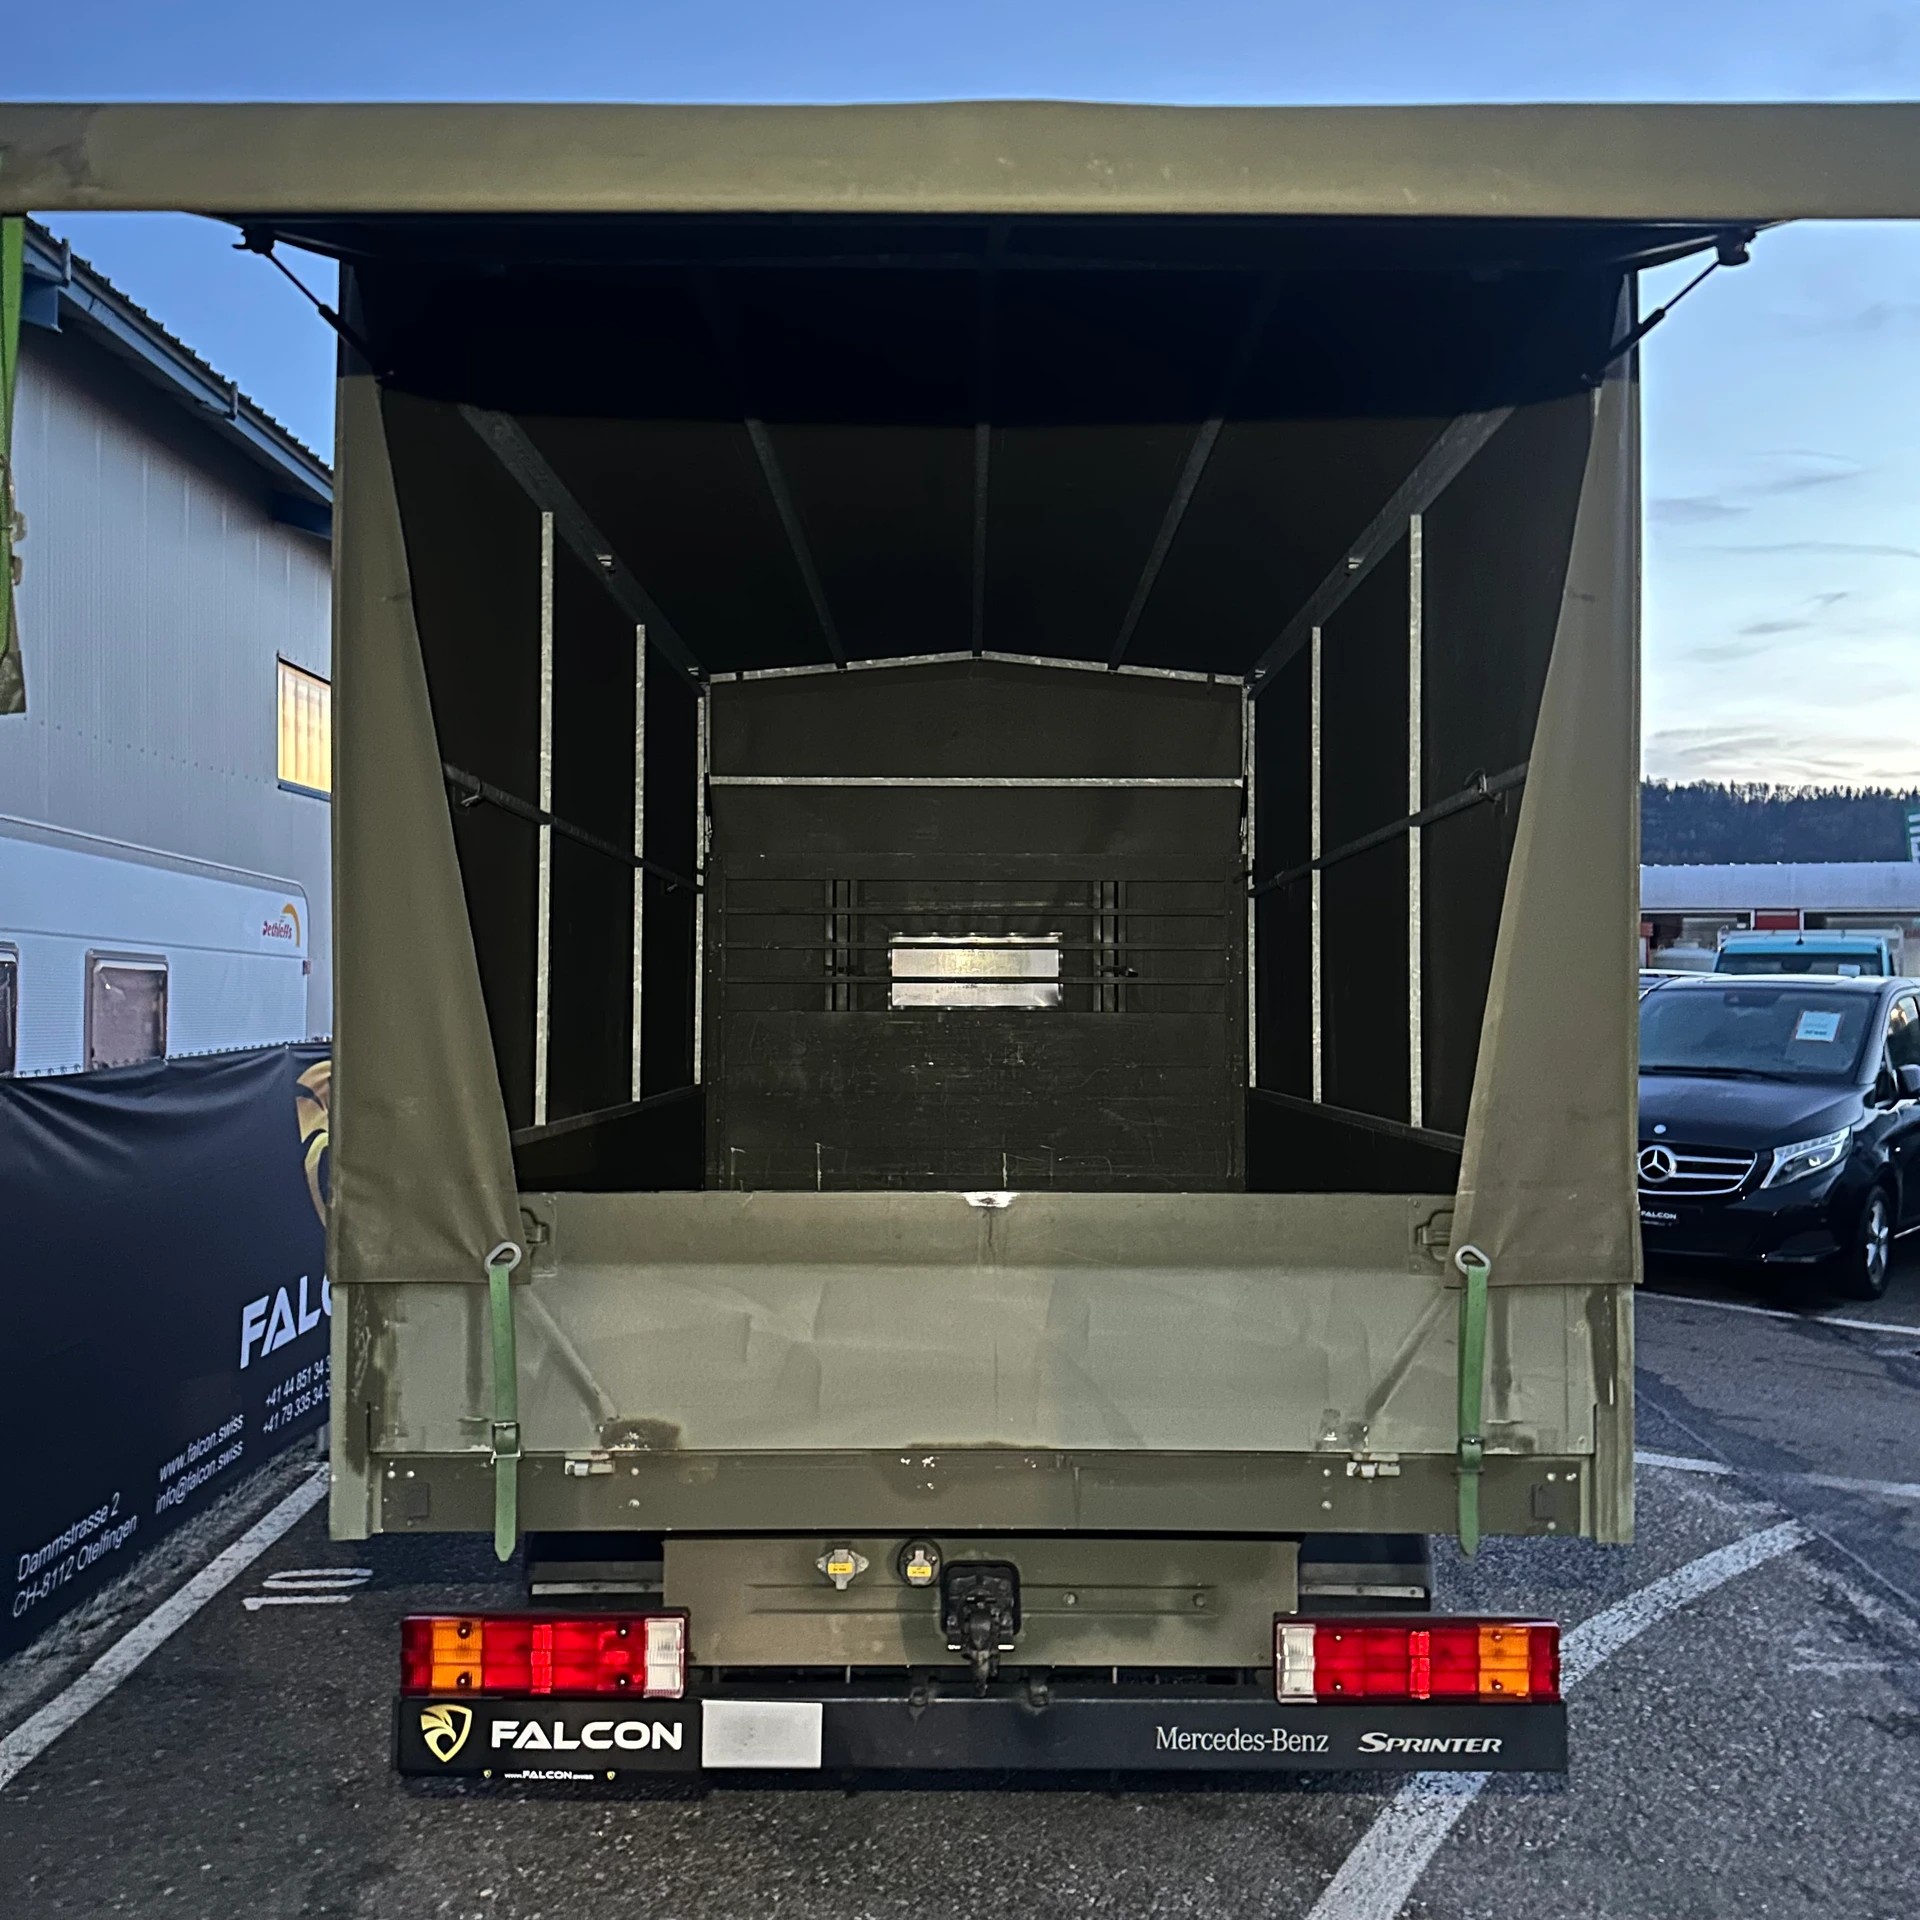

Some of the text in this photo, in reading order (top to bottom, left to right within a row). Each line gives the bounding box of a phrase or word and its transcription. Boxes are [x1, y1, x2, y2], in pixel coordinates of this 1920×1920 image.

[1640, 1210, 1677, 1220] FALCON
[266, 1384, 281, 1407] +41
[283, 1377, 295, 1397] 44
[296, 1366, 312, 1391] 851
[313, 1359, 324, 1380] 34
[263, 1412, 279, 1434] +41
[281, 1403, 293, 1425] 79
[312, 1384, 323, 1405] 34
[160, 1414, 244, 1482] www.falcon.swiss
[155, 1441, 244, 1514] info@falcon.swiss
[17, 1492, 120, 1582] Dammstrasse 2
[13, 1515, 138, 1618] CH-8112 Otelfingen
[491, 1720, 683, 1750] FALCON
[1155, 1726, 1502, 1752] Mercedes-Benz SPRINTER
